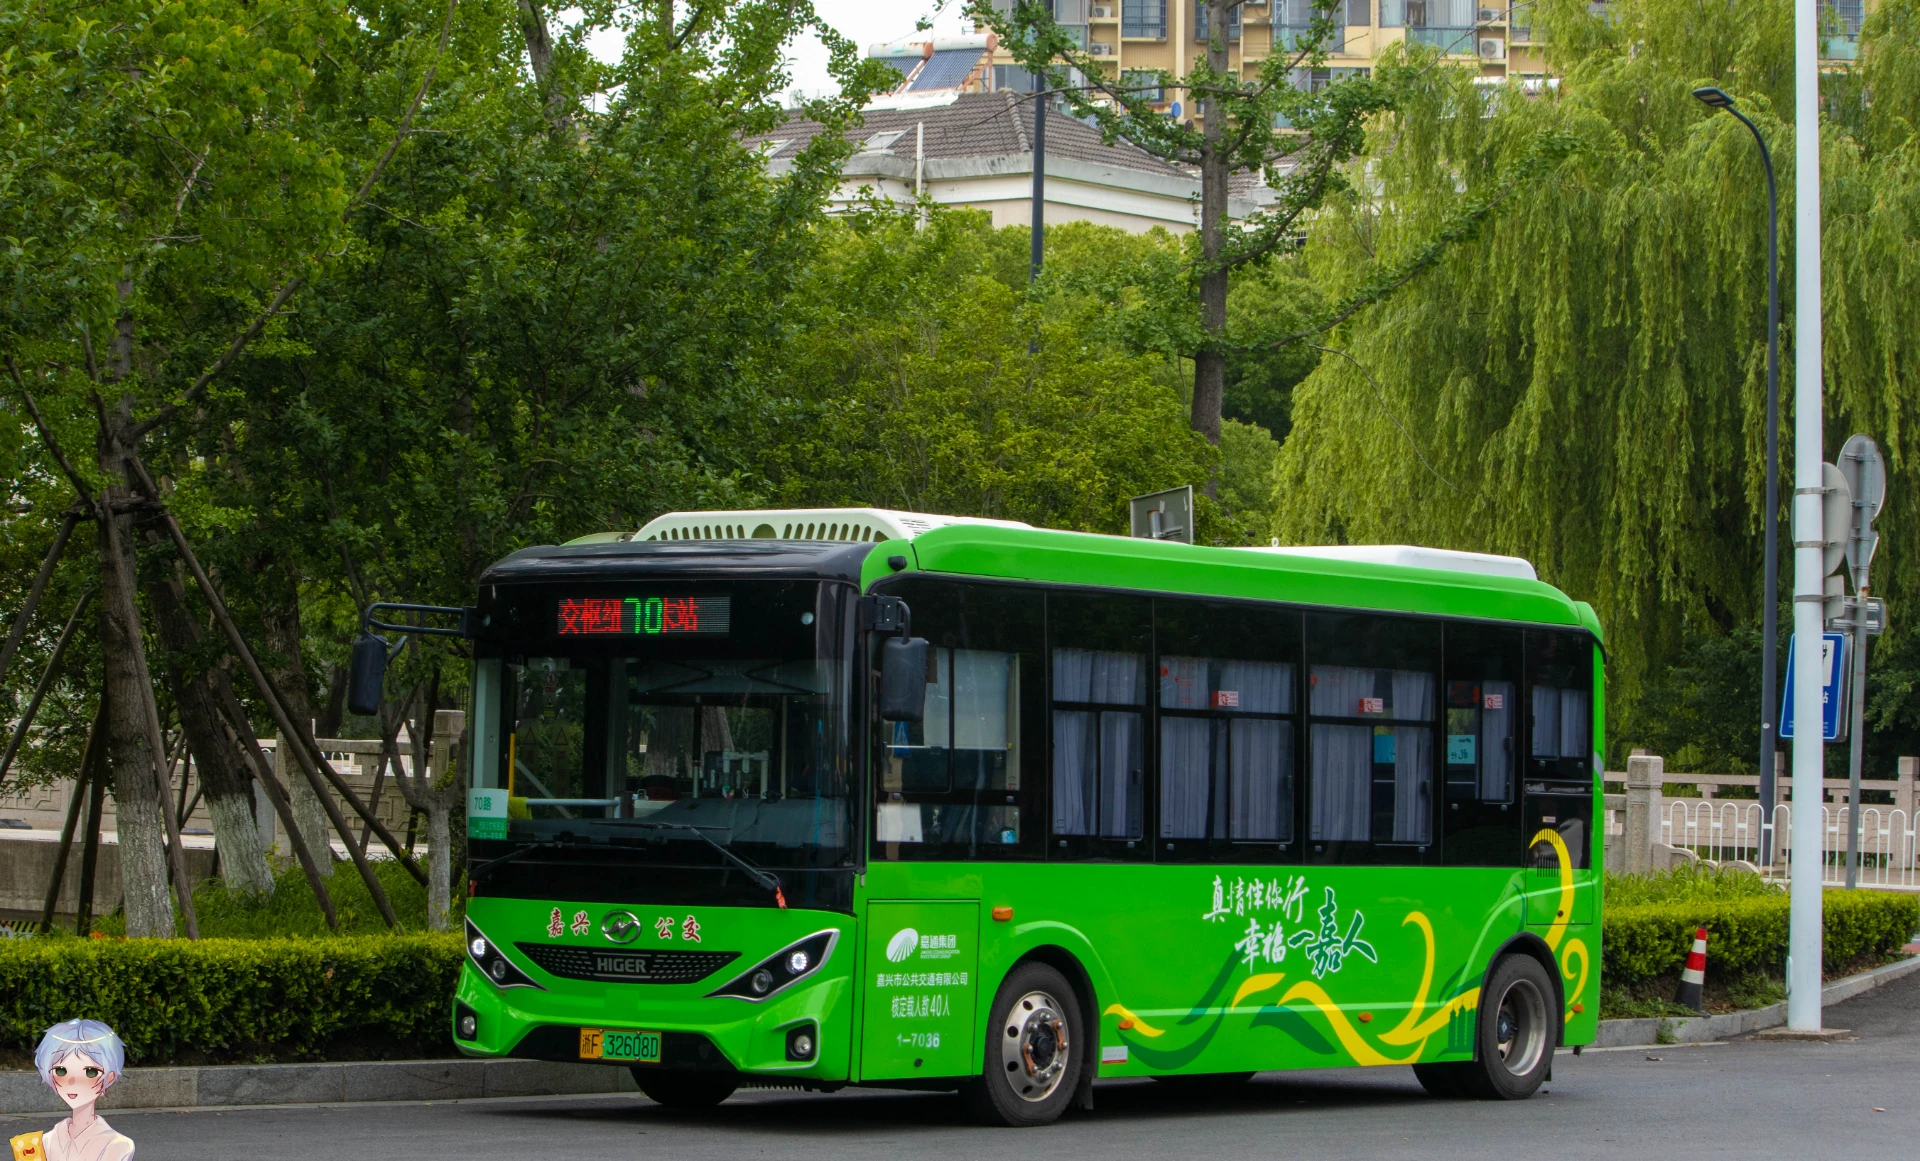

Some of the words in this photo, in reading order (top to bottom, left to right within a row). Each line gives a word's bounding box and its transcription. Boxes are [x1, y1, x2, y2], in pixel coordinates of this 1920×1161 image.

[624, 597, 663, 634] 70
[474, 796, 492, 811] 70路
[1203, 875, 1309, 923] 真情伴你行
[547, 907, 591, 938] 嘉兴
[654, 915, 701, 943] 公交
[920, 934, 957, 949] 嘉通集团
[597, 957, 647, 973] HIGER
[876, 972, 968, 987] 嘉兴市公共交通有限公司
[606, 1034, 659, 1058] 32608D
[897, 1032, 940, 1048] 1-7036
